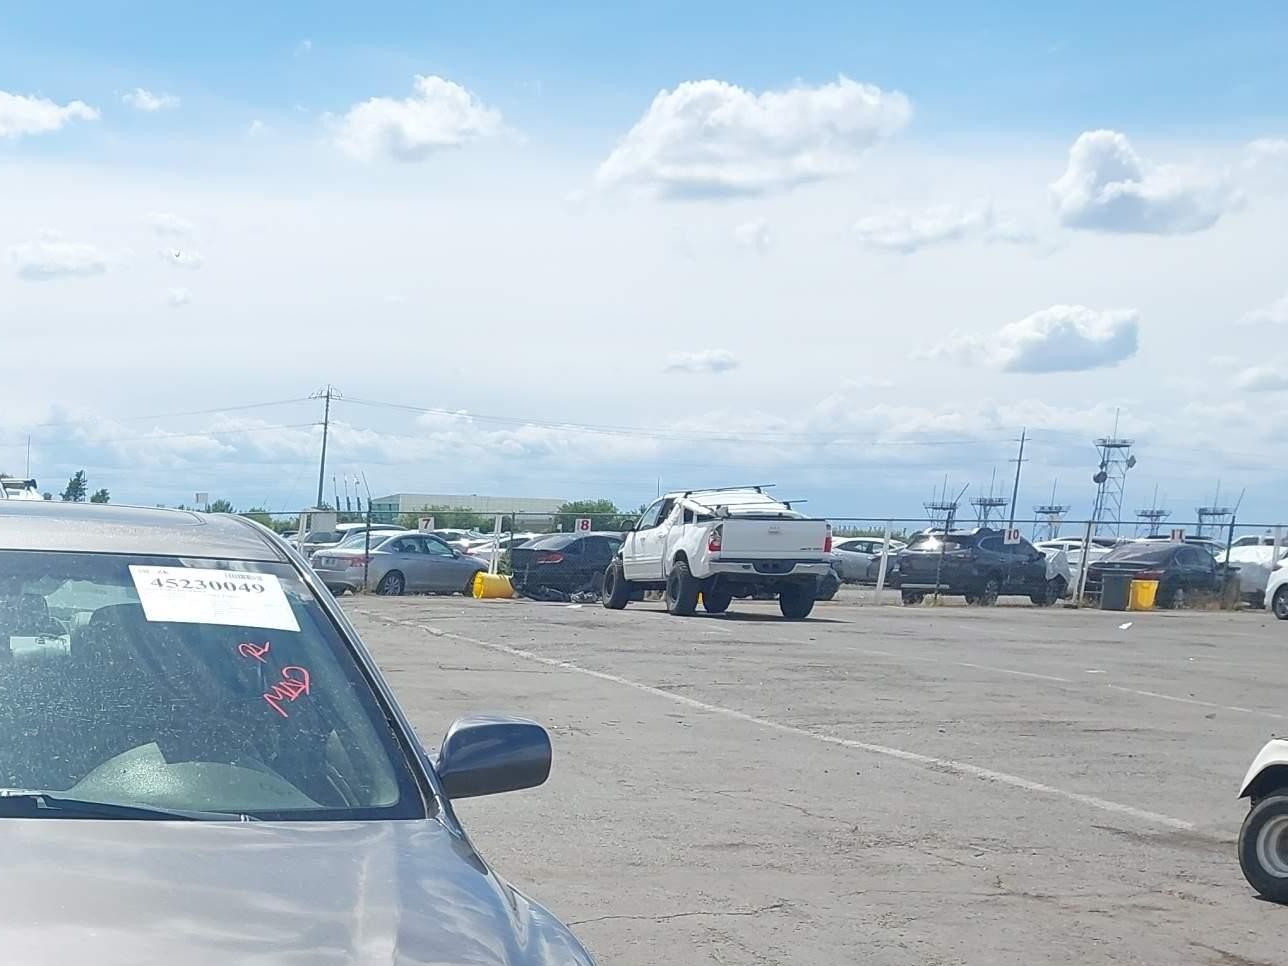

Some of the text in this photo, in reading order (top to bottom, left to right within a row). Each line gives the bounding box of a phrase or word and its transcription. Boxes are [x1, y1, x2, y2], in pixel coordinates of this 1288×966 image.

[422, 518, 431, 530] 7
[580, 519, 590, 531] 8
[1007, 529, 1020, 540] 10
[150, 577, 265, 594] 45230049
